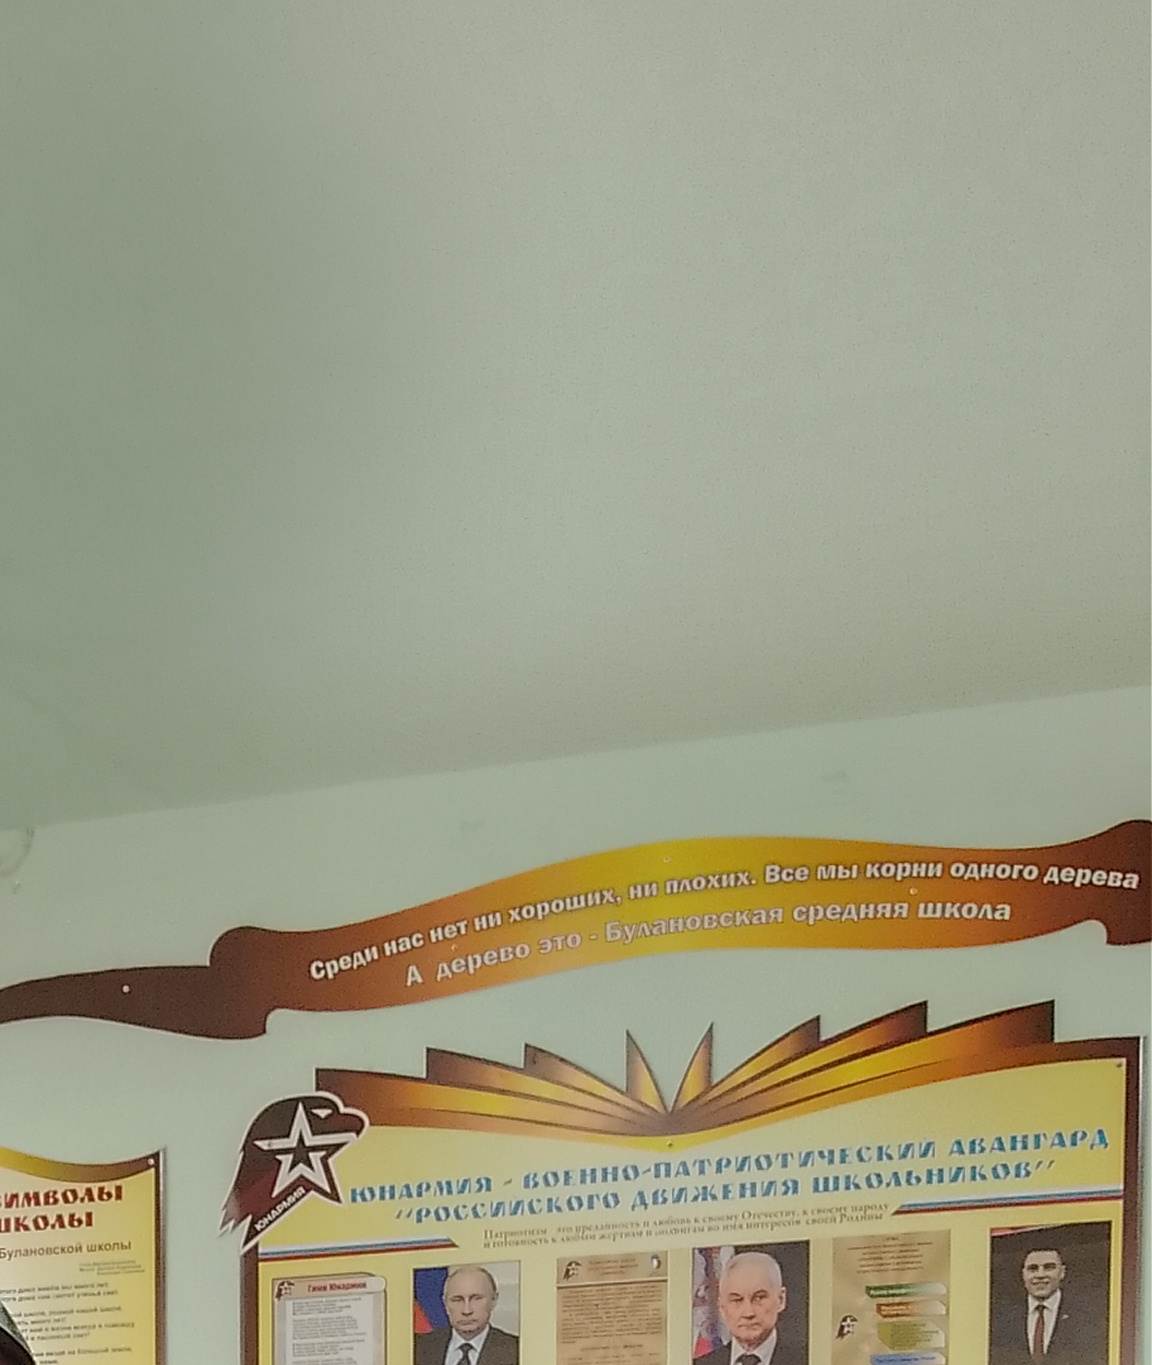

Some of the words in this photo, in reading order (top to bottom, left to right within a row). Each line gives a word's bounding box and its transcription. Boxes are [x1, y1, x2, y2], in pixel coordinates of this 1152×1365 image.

[309, 947, 379, 980] Среди
[384, 933, 425, 958] нас
[429, 919, 468, 944] нет
[474, 912, 502, 932] ни
[508, 885, 622, 925] хороших,
[629, 877, 659, 900] ни
[665, 865, 757, 897] плохих.
[765, 864, 809, 883] Все
[817, 863, 858, 880] мы
[865, 861, 942, 882] корни
[950, 861, 1038, 882] одного
[1042, 866, 1140, 890] дерева
[405, 964, 424, 987] А
[436, 944, 530, 982] дерево
[536, 932, 583, 955] это
[605, 902, 783, 945] Булановская
[792, 901, 909, 924] средняя
[916, 902, 1012, 921] школа
[350, 1176, 492, 1204] ЮНАРМИЯ
[949, 1128, 1110, 1157] АВАНГАРД
[630, 1176, 800, 1211] ДВИЖЕНИЯ
[254, 1186, 306, 1231] ЮНАРМИЯ
[86, 1241, 132, 1254] школы
